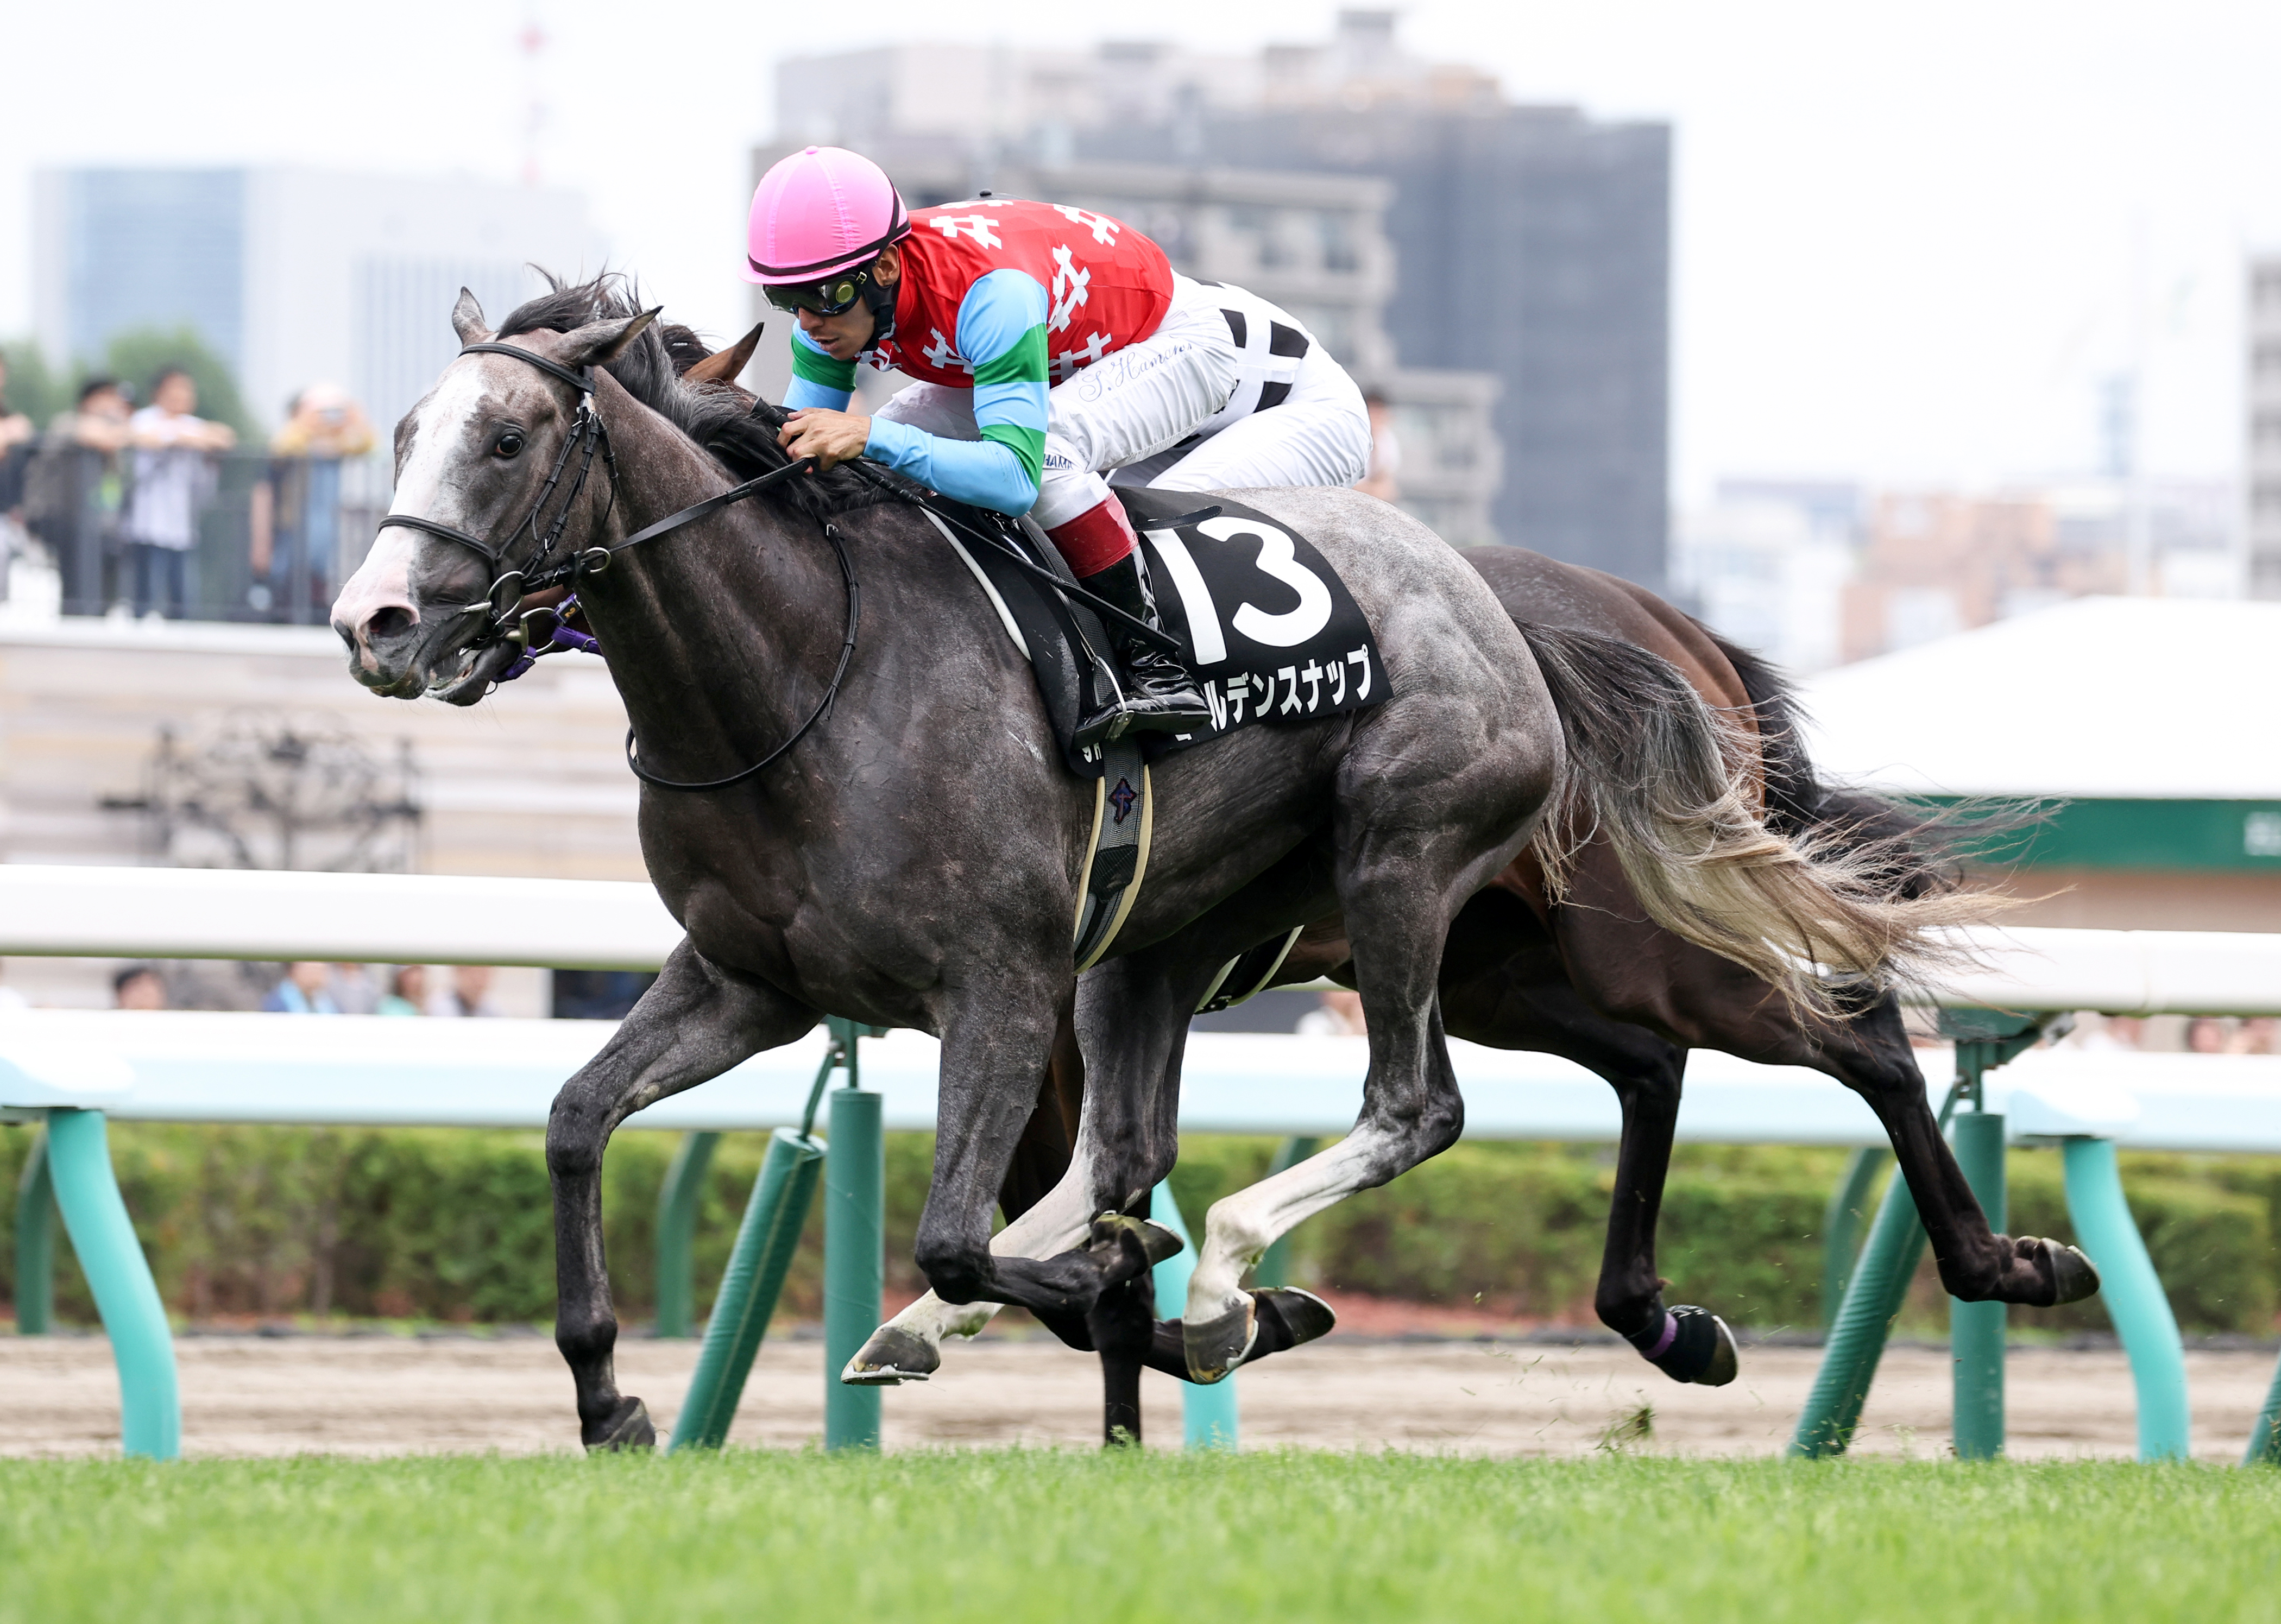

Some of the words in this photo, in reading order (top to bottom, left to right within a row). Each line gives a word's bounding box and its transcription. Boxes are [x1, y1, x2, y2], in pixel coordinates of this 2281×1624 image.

[1143, 516, 1332, 665] 13
[1175, 643, 1371, 741] ルデンスナップ
